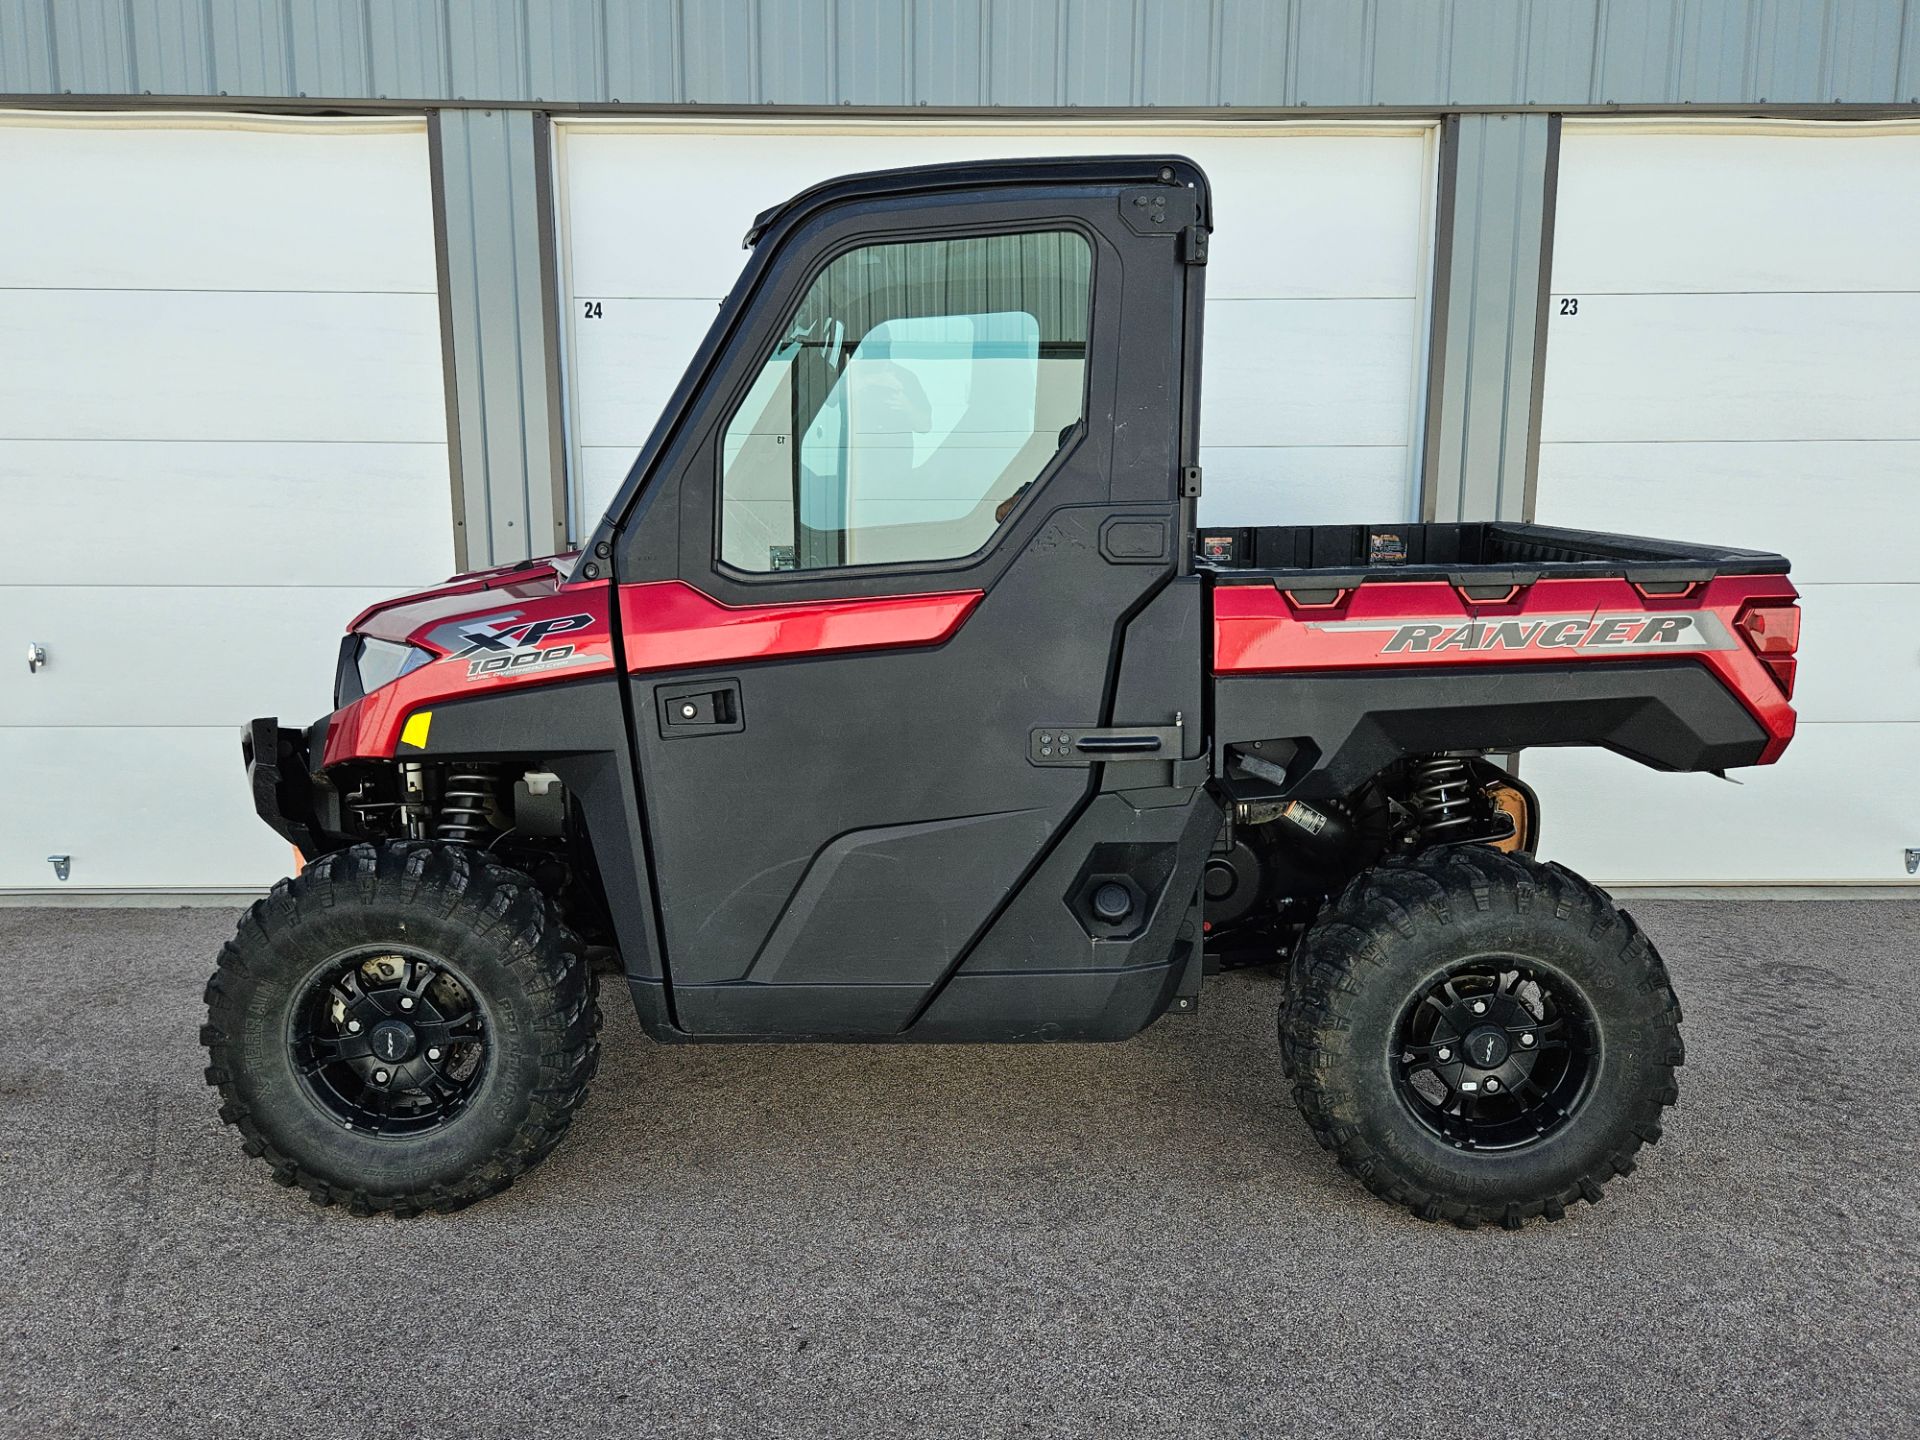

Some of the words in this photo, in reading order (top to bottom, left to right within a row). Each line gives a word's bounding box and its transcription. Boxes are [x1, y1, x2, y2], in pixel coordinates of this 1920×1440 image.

[584, 301, 603, 319] 24
[1560, 298, 1578, 316] 23
[436, 612, 596, 664] XP
[1381, 614, 1695, 653] RANGER
[466, 644, 575, 677] 1000
